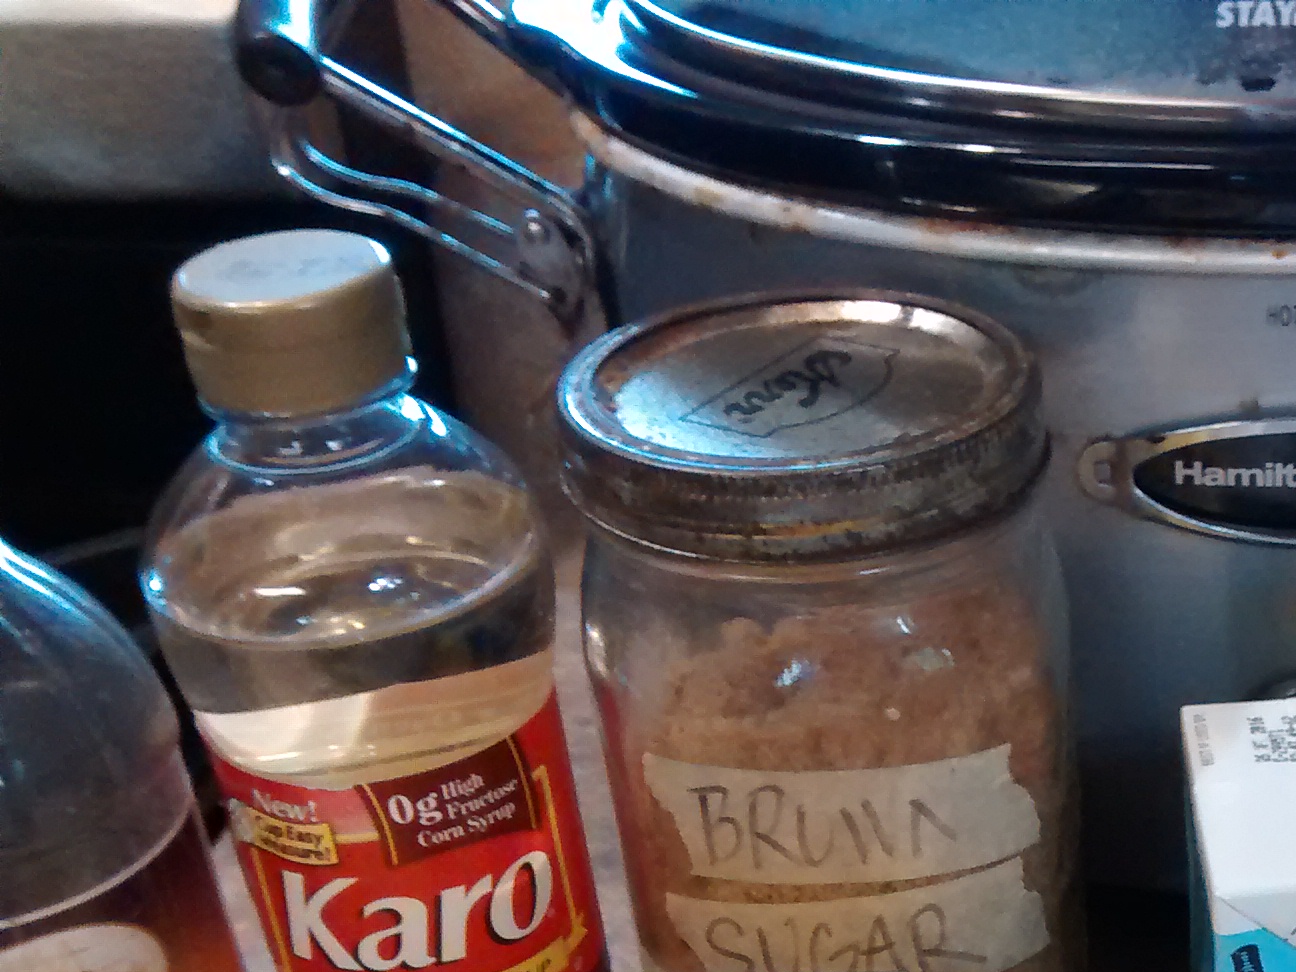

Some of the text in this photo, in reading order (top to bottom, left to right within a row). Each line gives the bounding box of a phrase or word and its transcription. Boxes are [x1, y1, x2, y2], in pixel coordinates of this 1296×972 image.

[441, 774, 485, 801] High
[446, 779, 518, 820] Fructose
[417, 802, 517, 848] Corn Syrup
[282, 850, 554, 972] Karo
